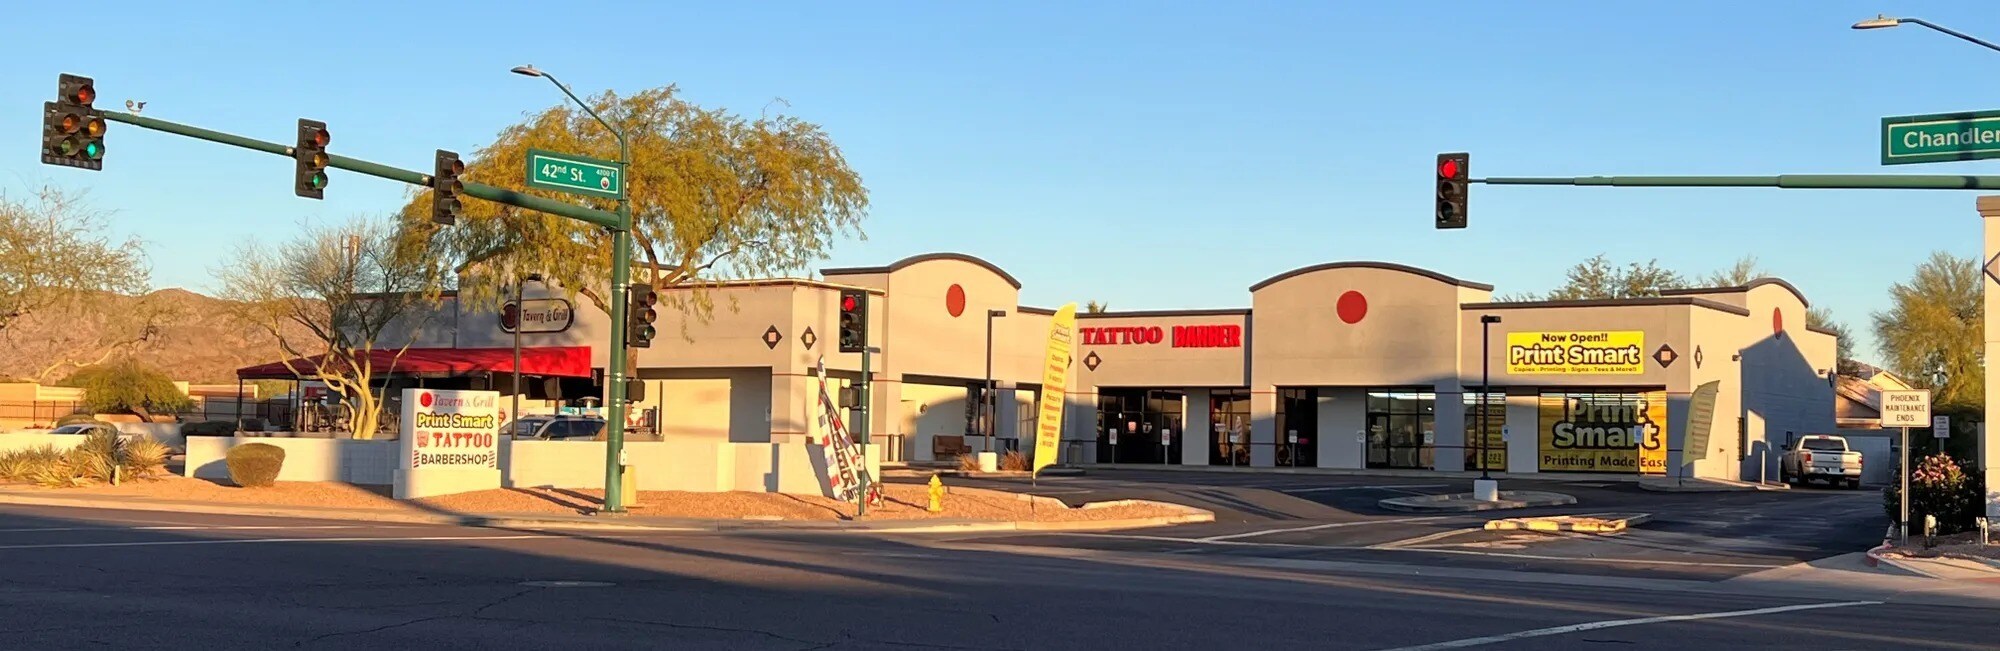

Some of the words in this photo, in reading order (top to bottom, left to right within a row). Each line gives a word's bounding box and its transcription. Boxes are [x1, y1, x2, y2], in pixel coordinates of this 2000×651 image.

[1903, 127, 2000, 148] Chandler
[541, 163, 567, 178] 42nd
[570, 167, 586, 182] St.
[523, 308, 545, 323] Tavern
[546, 309, 552, 322] &
[553, 307, 568, 321] Grill
[1079, 326, 1164, 345] TATTOO
[1171, 324, 1241, 348] BARBER
[1541, 333, 1567, 342] Now
[1569, 333, 1608, 343] Open!!
[1511, 343, 1565, 365] Print
[1568, 344, 1640, 365] Smart
[433, 393, 463, 407] Tavern
[465, 398, 471, 407] &
[473, 395, 494, 408] Grill
[1890, 394, 1920, 402] PHOENIX
[1565, 398, 1648, 424] Print
[1885, 404, 1925, 412] MAINTENANCE
[416, 411, 450, 428] Print
[452, 413, 494, 429] Smart
[1896, 414, 1915, 422] ENDS
[433, 432, 493, 448] TATTOO
[421, 453, 488, 465] BARBERSHOP
[1544, 455, 1595, 468] Printing
[1600, 455, 1635, 467] Made
